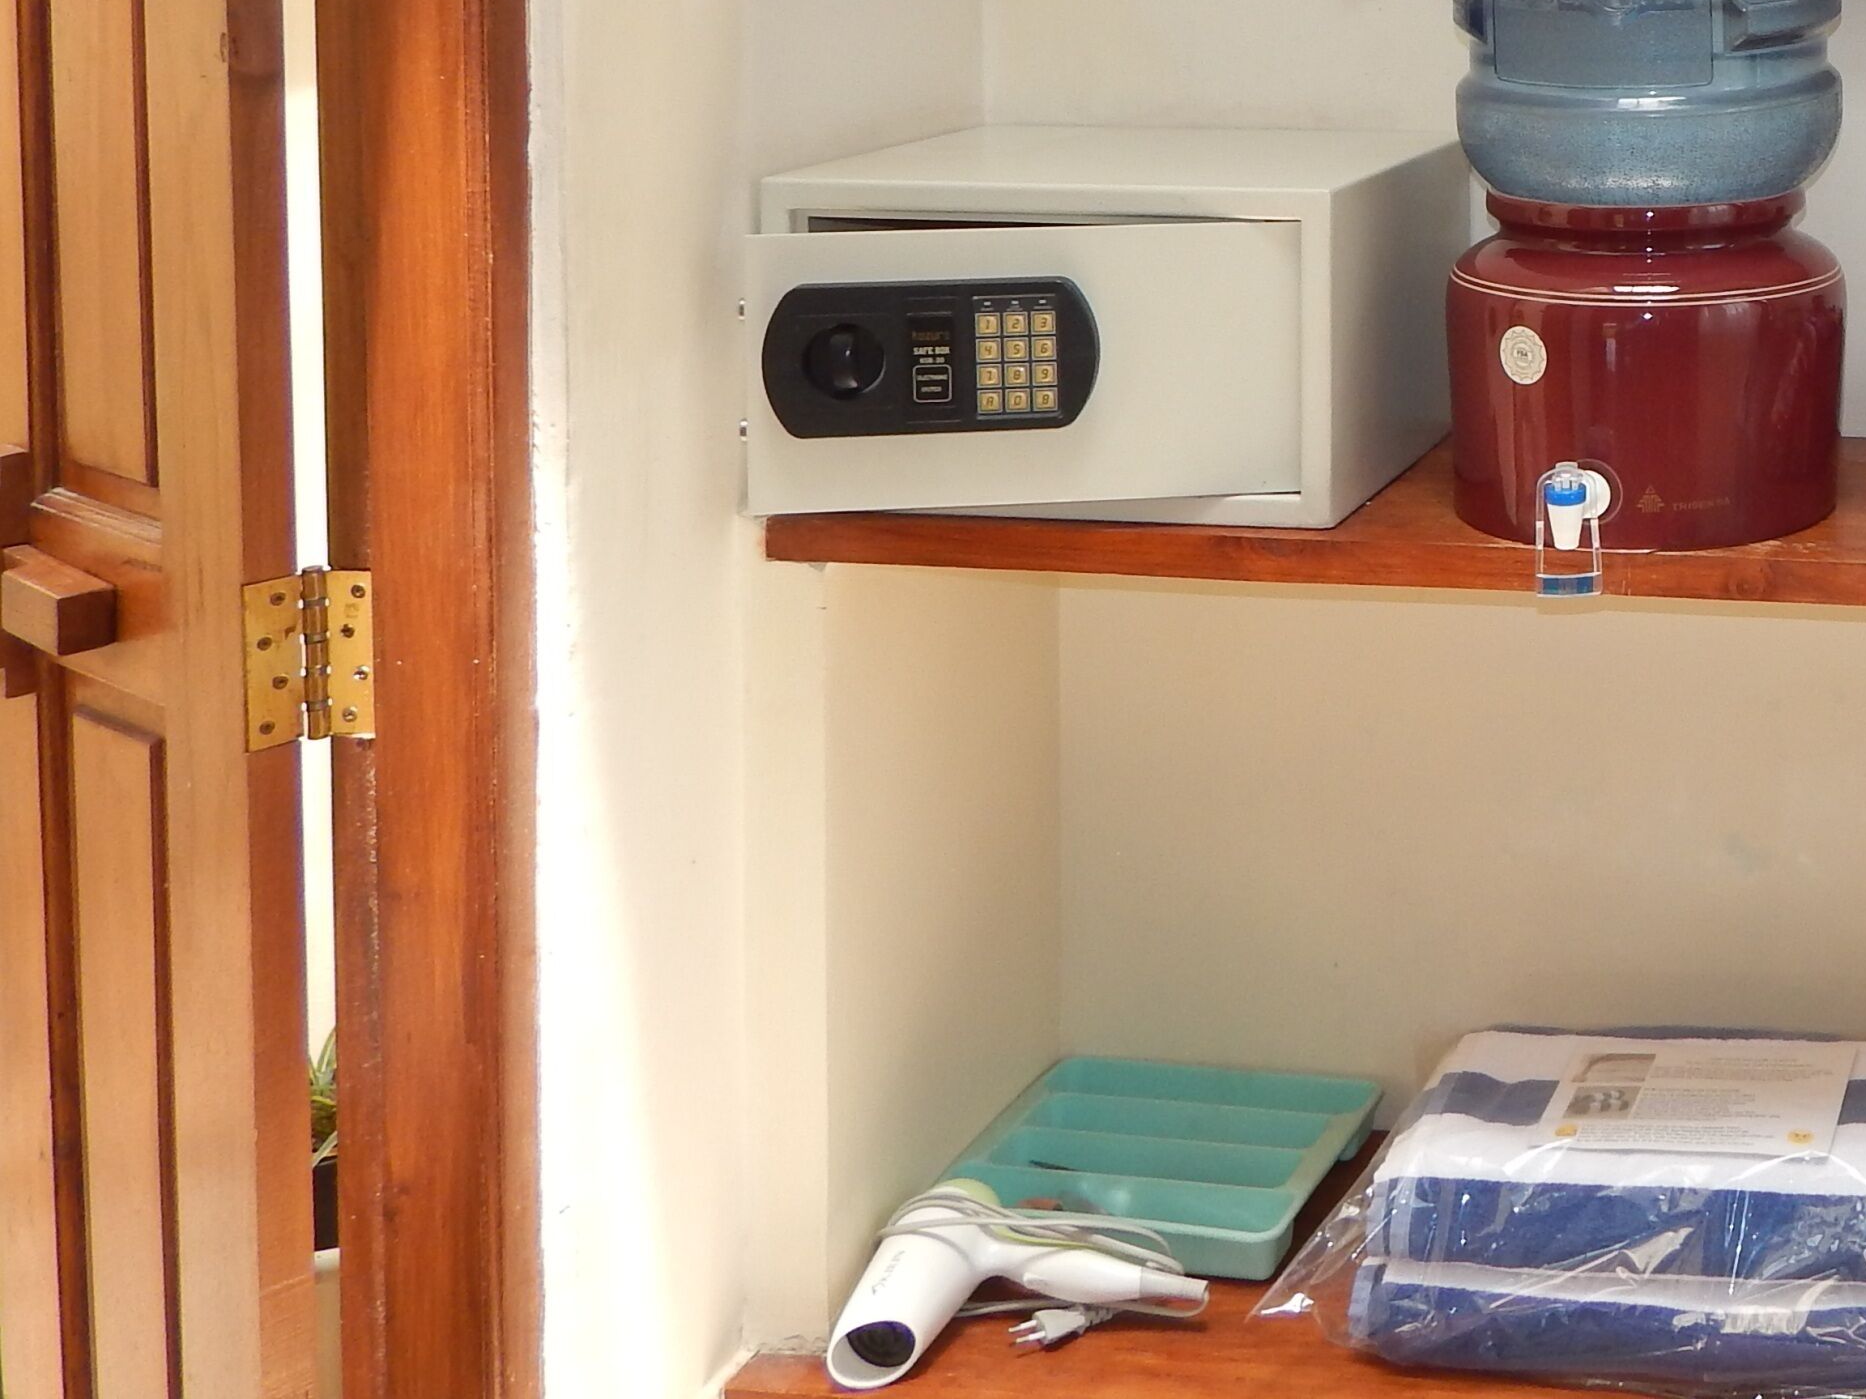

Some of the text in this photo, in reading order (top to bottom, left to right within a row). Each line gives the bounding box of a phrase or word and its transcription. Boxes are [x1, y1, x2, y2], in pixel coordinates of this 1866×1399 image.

[1011, 318, 1020, 329] 2
[1039, 317, 1048, 328] 3
[1012, 344, 1021, 355] 5
[1040, 342, 1049, 354] 6
[1013, 369, 1022, 381] 8
[1041, 368, 1049, 380] 9
